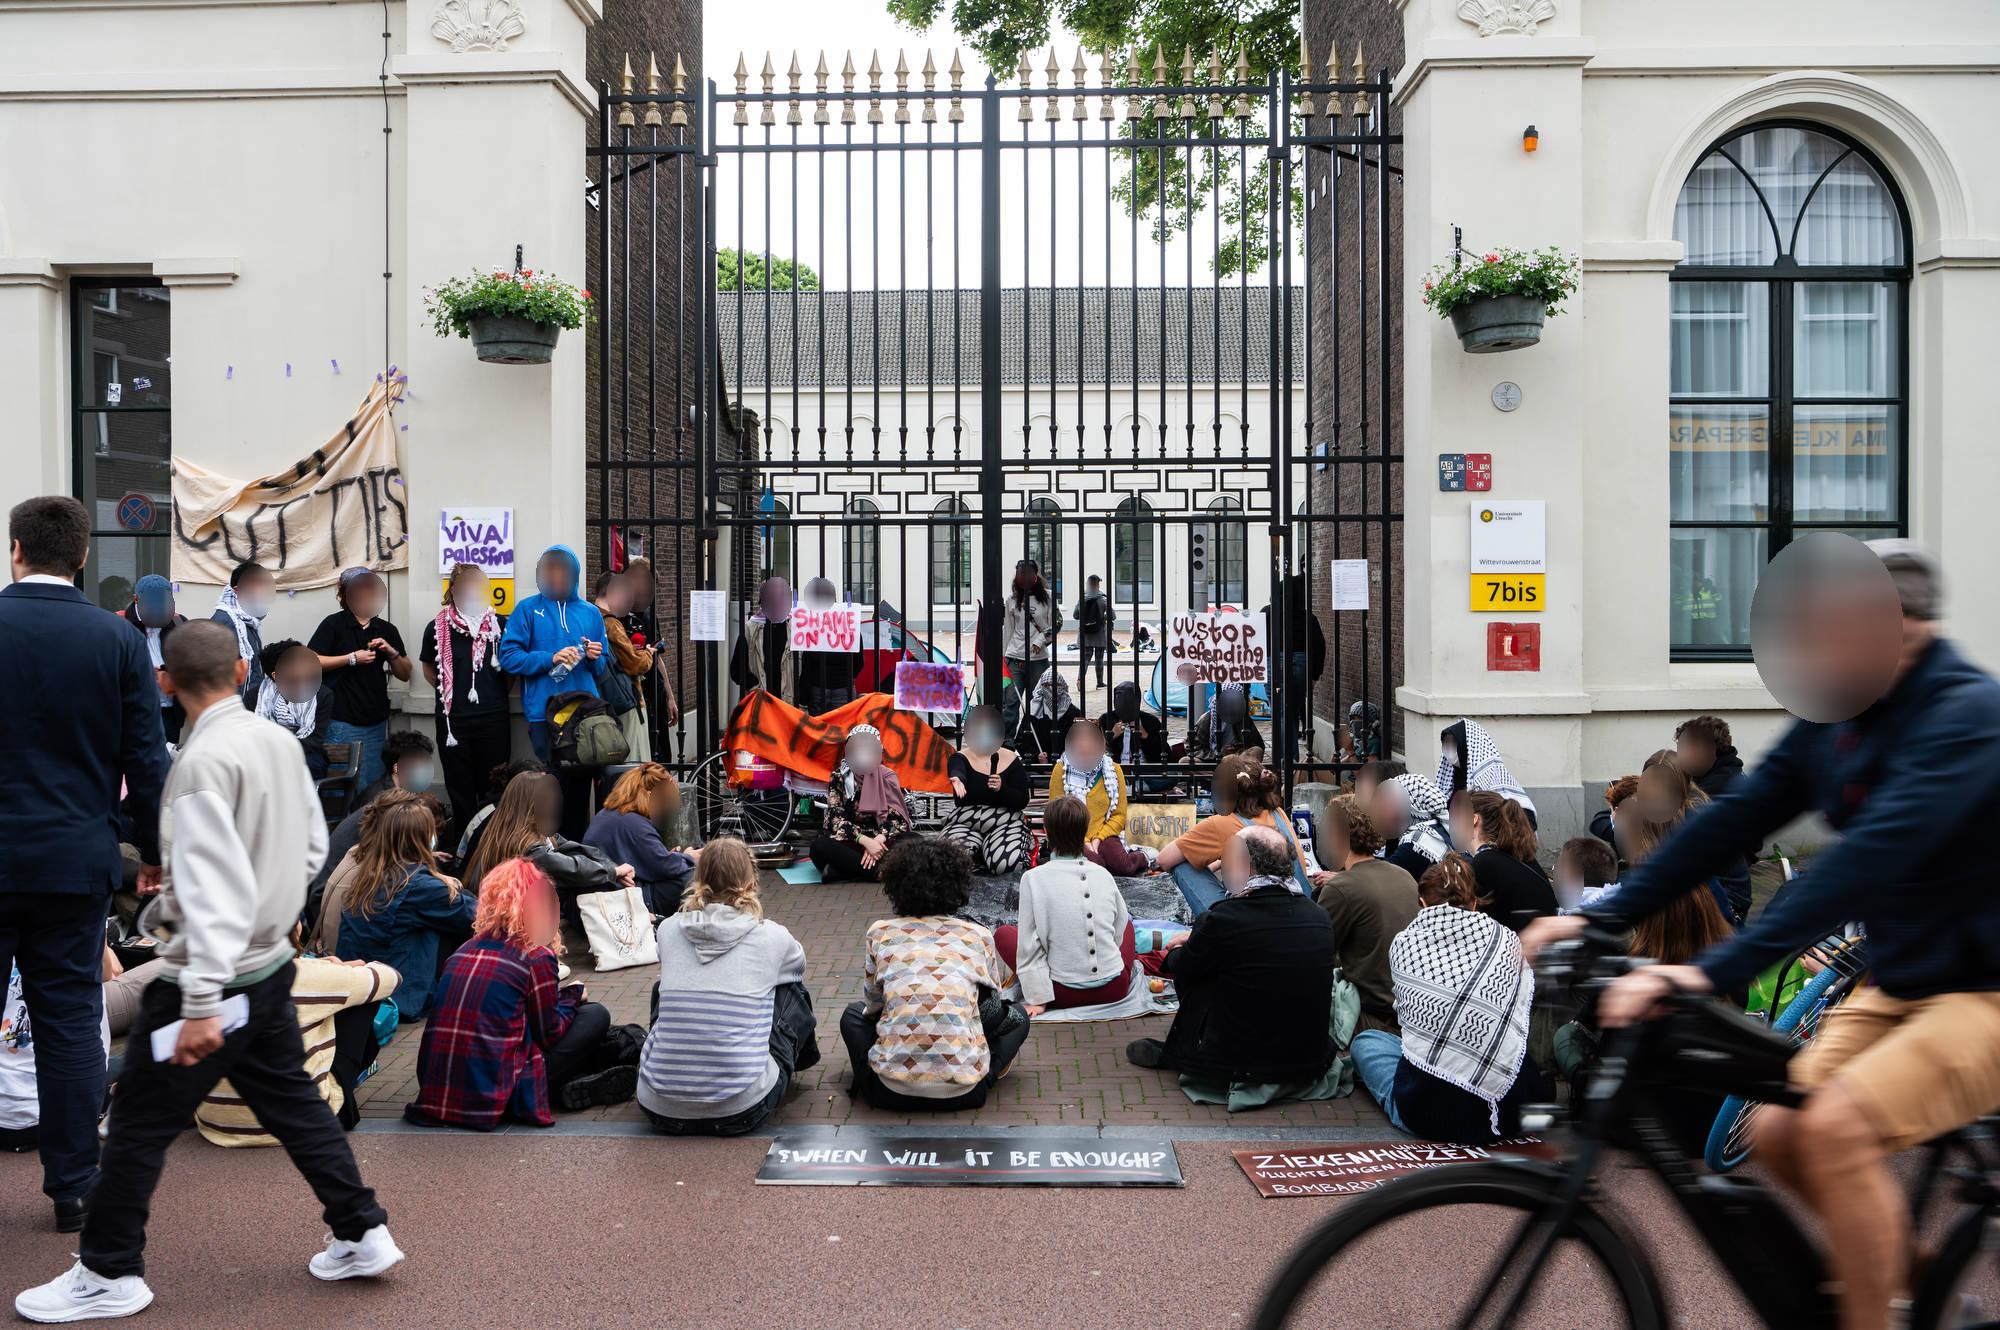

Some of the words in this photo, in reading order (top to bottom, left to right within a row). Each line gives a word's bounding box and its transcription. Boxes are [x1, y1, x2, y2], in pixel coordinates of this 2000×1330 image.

[1479, 558, 1541, 566] Wittevrouwenstraat
[1486, 581, 1537, 602] 7bis
[793, 608, 856, 635] SHAME
[793, 630, 819, 648] ON
[827, 632, 855, 651] UU
[1171, 638, 1264, 666] defending
[1011, 1151, 1041, 1167] BE
[1050, 1151, 1167, 1169] ENOUGH?
